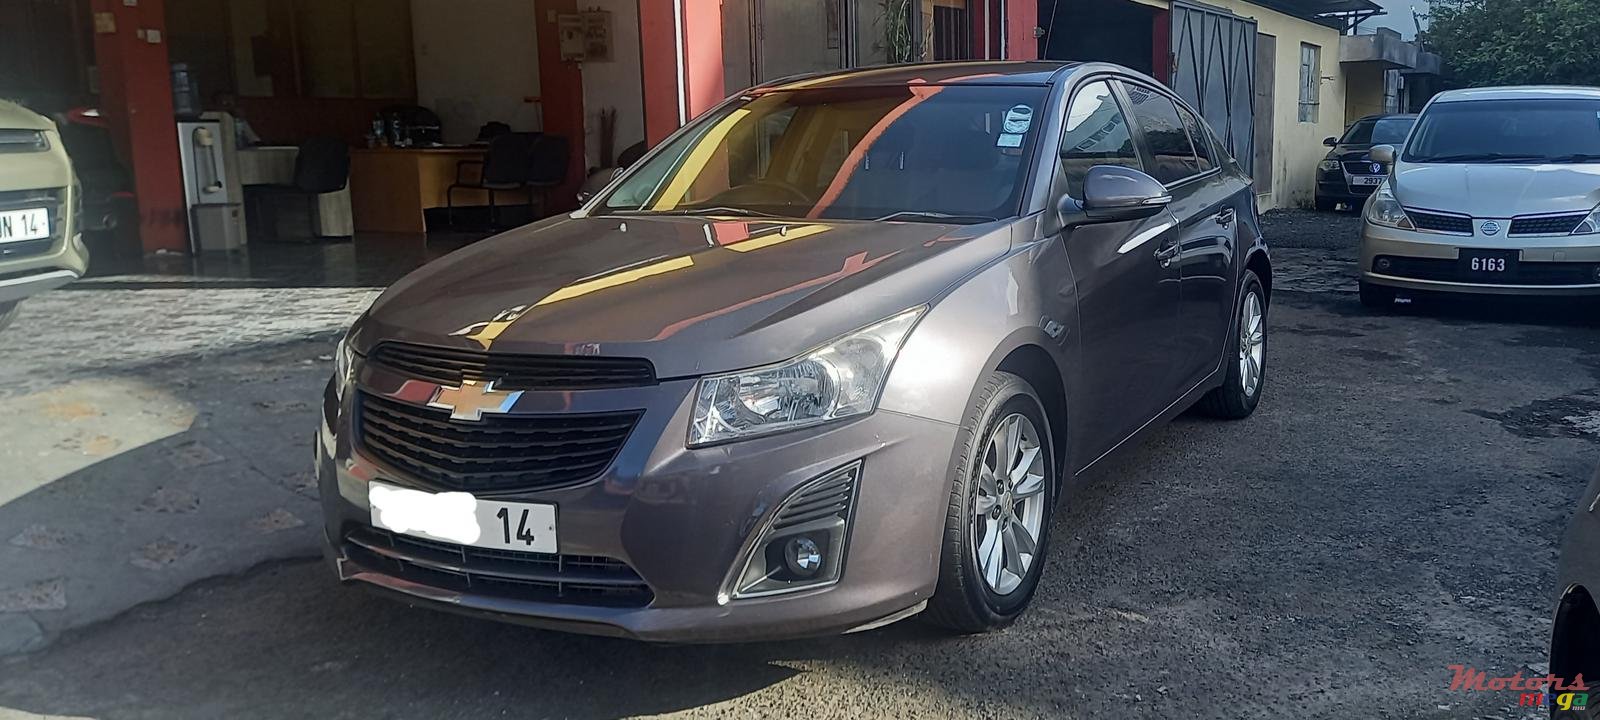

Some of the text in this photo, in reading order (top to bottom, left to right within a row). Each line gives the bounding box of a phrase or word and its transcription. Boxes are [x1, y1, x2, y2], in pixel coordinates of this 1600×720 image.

[21, 213, 39, 236] 14
[1471, 257, 1505, 272] 6163
[496, 507, 535, 546] 14
